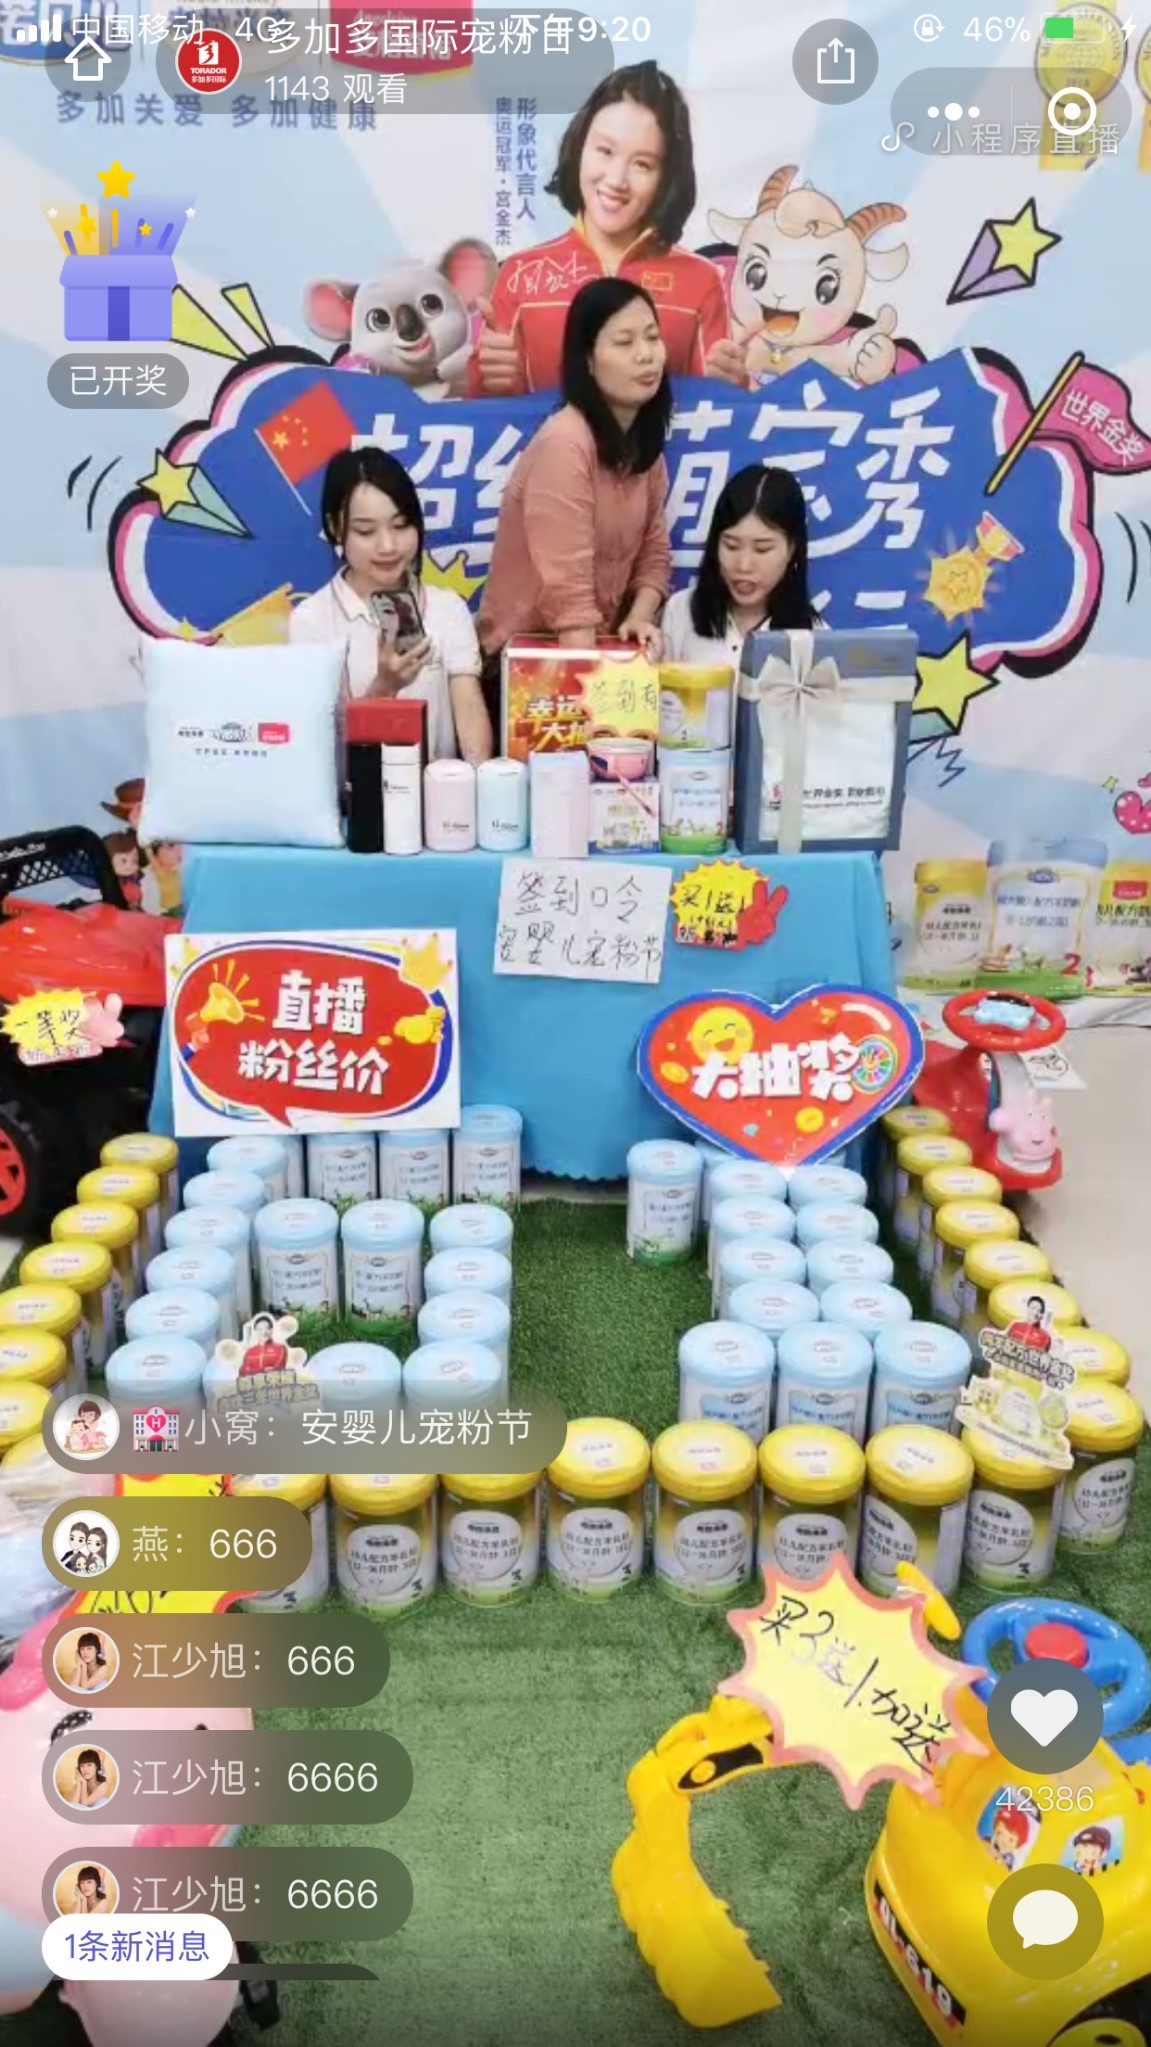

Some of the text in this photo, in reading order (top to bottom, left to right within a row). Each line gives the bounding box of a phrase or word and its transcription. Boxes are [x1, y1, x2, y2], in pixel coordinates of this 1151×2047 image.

[57, 89, 377, 131] 多加关爱 多加健康
[516, 96, 537, 222] 形象代言人
[1060, 389, 1145, 468] 世界金奖
[515, 871, 643, 923] 签到口令
[1061, 952, 1082, 977] 2
[271, 969, 368, 1037] 直播
[238, 1036, 391, 1096] 粉丝价
[691, 1032, 864, 1103] 大抽奖
